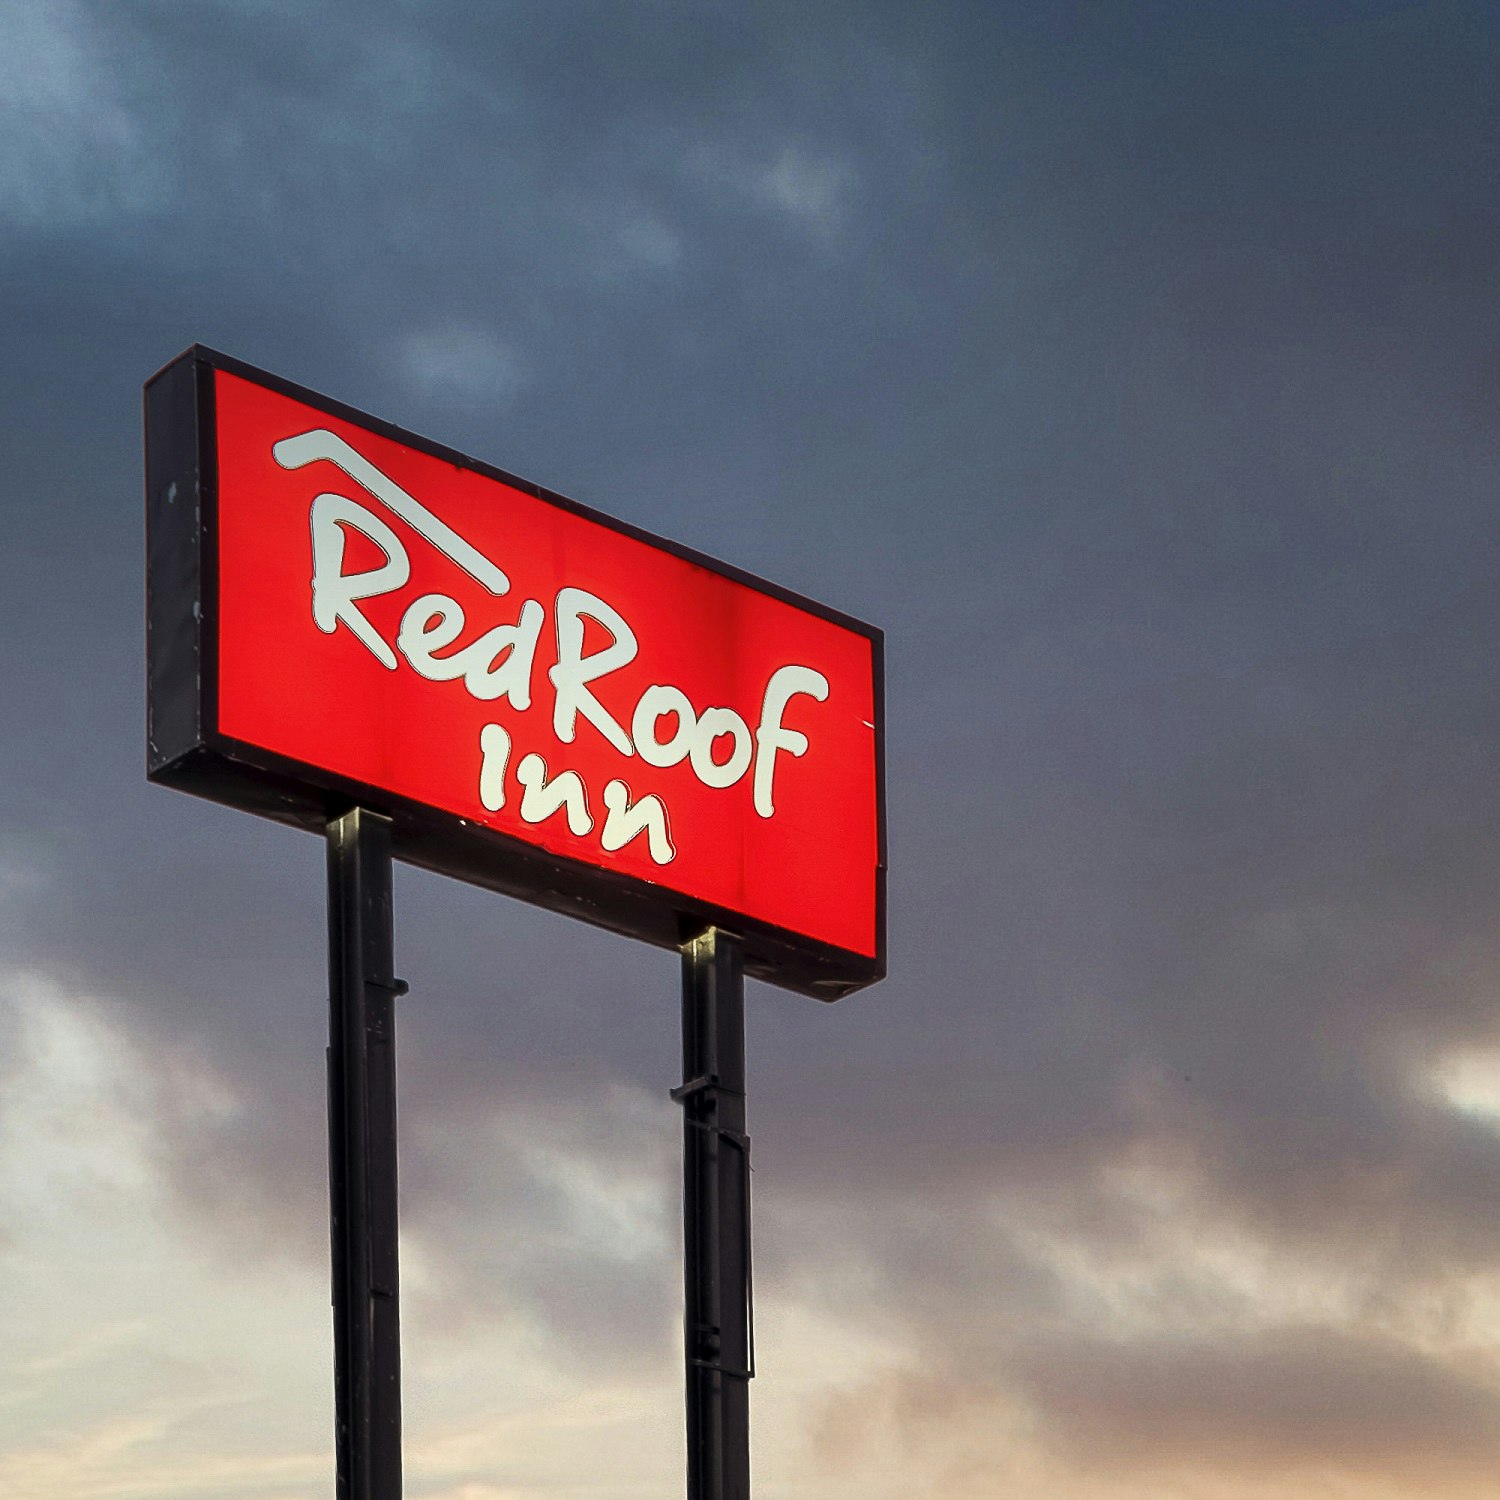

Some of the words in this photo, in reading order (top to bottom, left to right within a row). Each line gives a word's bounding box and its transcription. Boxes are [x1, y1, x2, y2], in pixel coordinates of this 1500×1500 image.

[310, 492, 545, 712] Red
[548, 586, 829, 820] Roof
[479, 722, 678, 866] Inn
